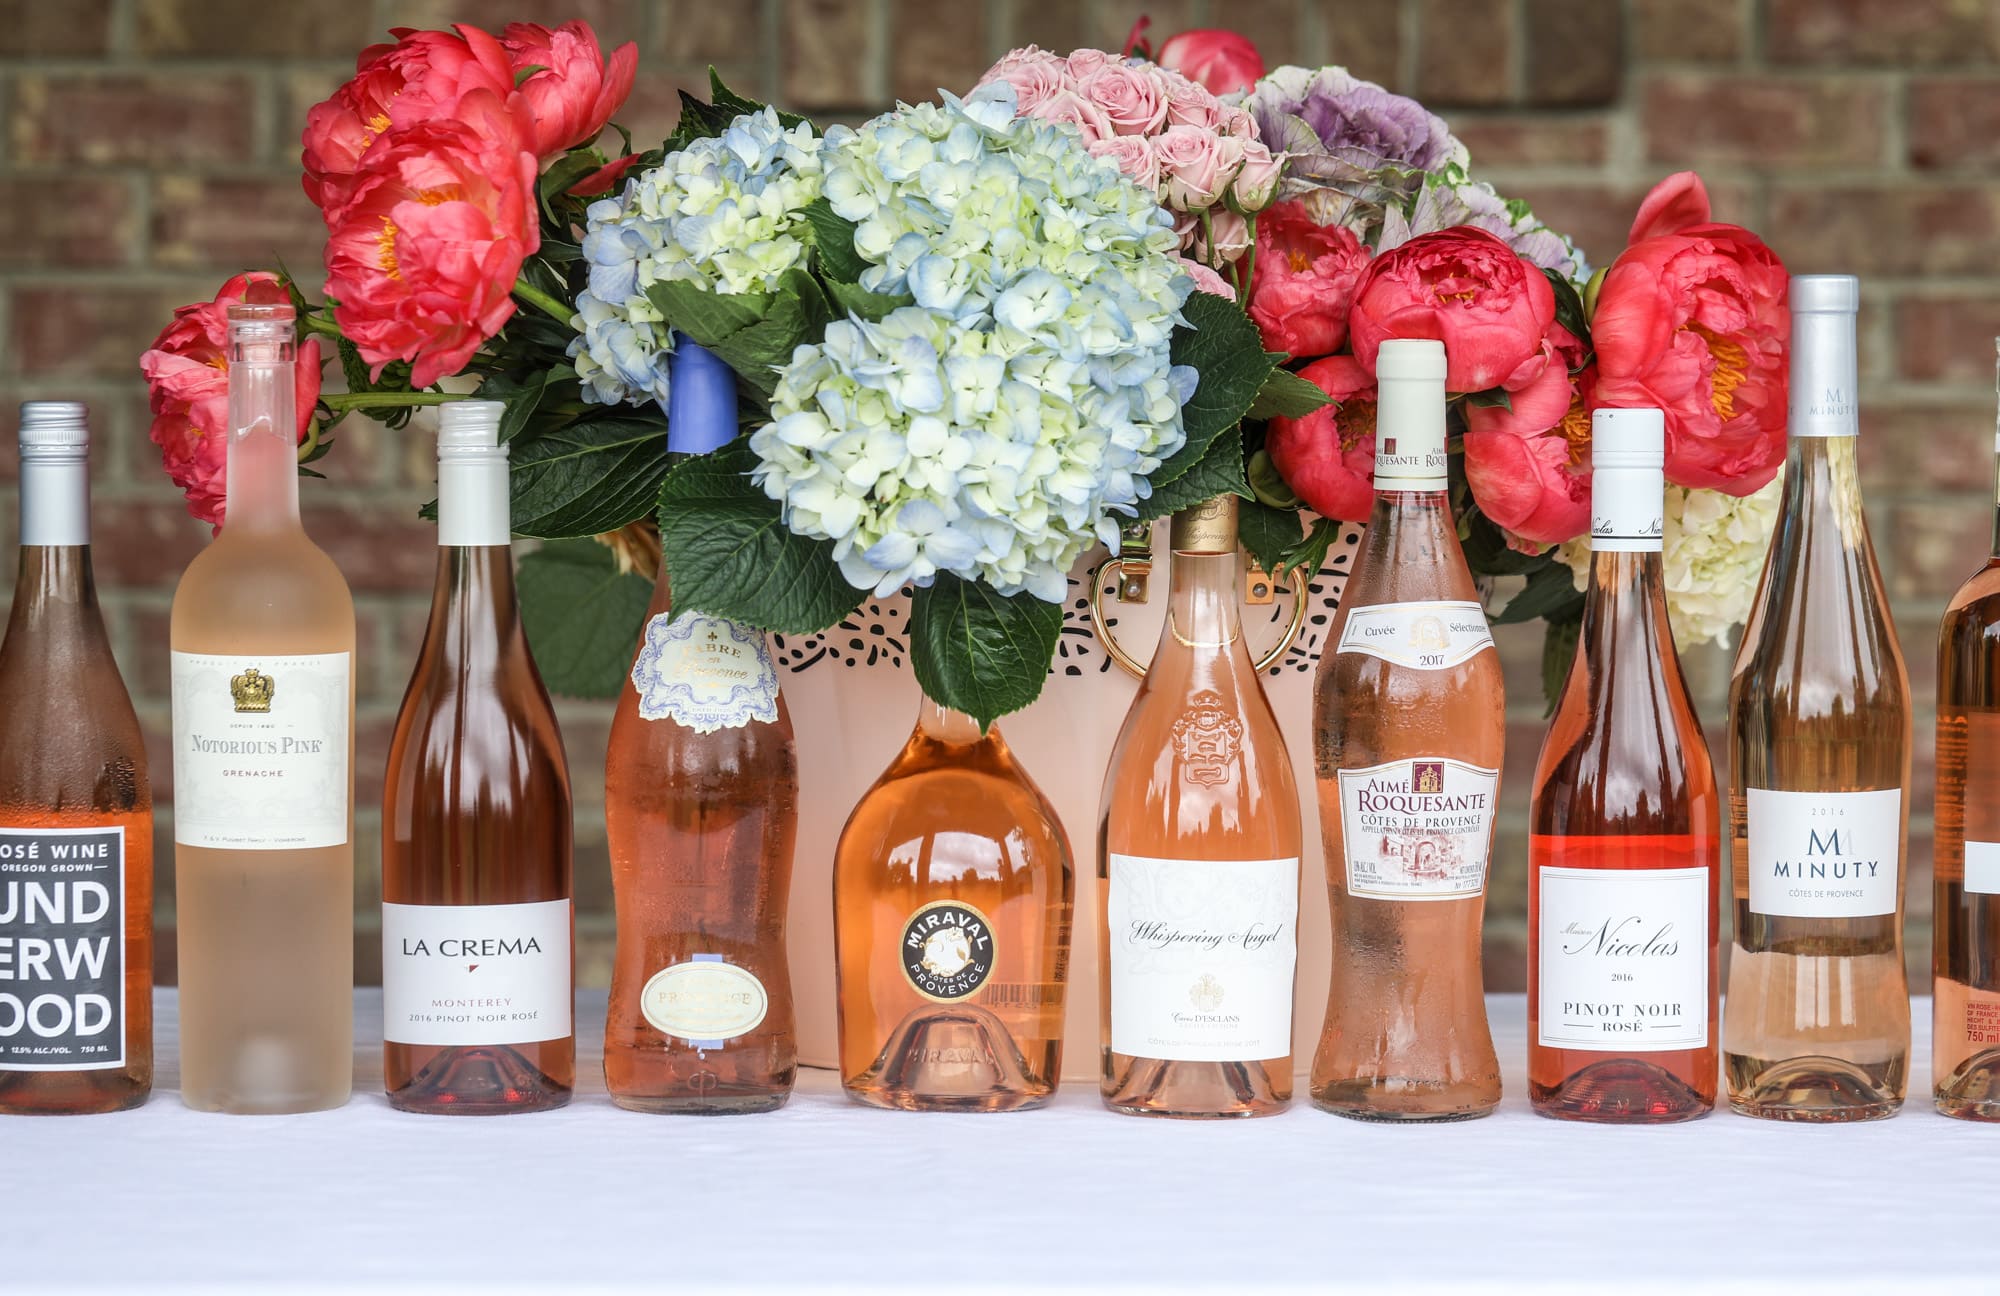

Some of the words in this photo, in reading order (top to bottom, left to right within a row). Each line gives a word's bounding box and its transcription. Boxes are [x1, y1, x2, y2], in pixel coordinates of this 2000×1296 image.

[1364, 624, 1396, 637] Cuvée
[1419, 655, 1445, 666] 2017
[191, 734, 278, 755] NOTORIOUS
[281, 736, 322, 754] PINK
[222, 769, 285, 778] GRENACHE
[1367, 778, 1409, 794] AIMÉ
[1358, 790, 1486, 815] ROQUESANTE
[1811, 808, 1845, 816] 2016
[1361, 814, 1397, 827] CÔTES
[1404, 817, 1420, 828] DE
[1425, 814, 1481, 828] PROVENCE
[51, 843, 109, 860] WINE
[1, 863, 47, 873] OREGON
[1773, 860, 1878, 879] MINUTY
[1788, 888, 1812, 898] CÔTES
[1814, 890, 1824, 898] DE
[1826, 889, 1865, 898] PROVENCE
[907, 911, 989, 950] MIRAVAL
[1559, 921, 1592, 935] Maison
[1128, 919, 1224, 951] Whispering
[1228, 922, 1283, 951] Angel
[1562, 915, 1679, 957] Nicolas
[402, 937, 431, 956] LA
[439, 936, 542, 957] CREMA
[911, 963, 985, 995] PROVENCE
[957, 972, 967, 981] DE
[1611, 973, 1634, 982] 2016
[431, 998, 512, 1008] MONTEREY
[1563, 1002, 1624, 1017] PINOT
[1634, 1003, 1682, 1017] NOIR
[409, 1013, 432, 1022] 2016
[436, 1015, 471, 1023] PINOT
[477, 1014, 507, 1023] NOIR
[511, 1010, 539, 1021] ROSÉ
[1602, 1020, 1643, 1033] ROSÉ
[1967, 1031, 1984, 1042] 750
[1986, 1033, 1999, 1043] ml
[80, 1045, 96, 1054] 750
